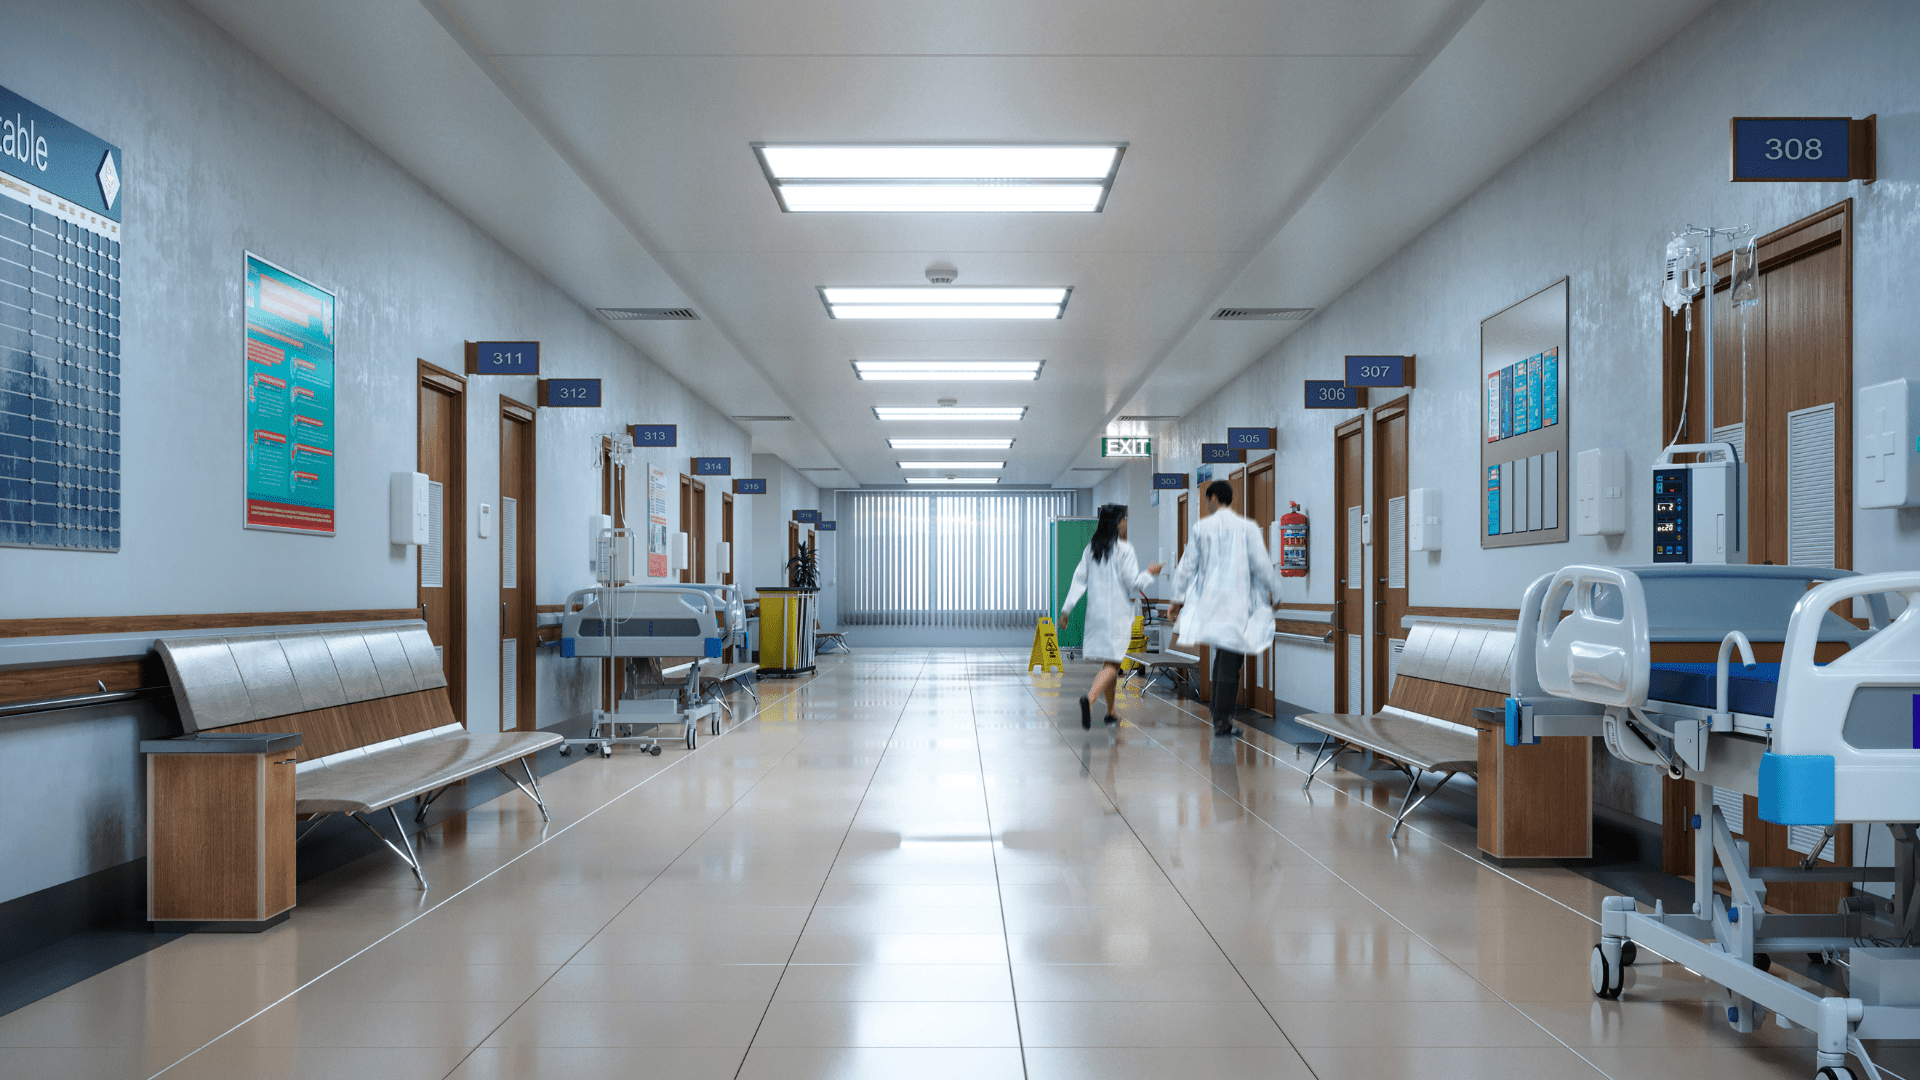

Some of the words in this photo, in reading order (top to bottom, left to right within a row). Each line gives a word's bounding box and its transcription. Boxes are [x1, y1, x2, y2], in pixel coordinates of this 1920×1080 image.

[1765, 138, 1823, 160] 308
[493, 352, 522, 365] 311
[1361, 365, 1390, 378] 307
[560, 387, 587, 399] 312
[1319, 387, 1346, 401] 306
[644, 431, 666, 441] 313
[1238, 434, 1260, 443] 305
[1107, 438, 1149, 455] EXIT
[1211, 449, 1231, 458] 304
[704, 462, 722, 471] 314
[1160, 477, 1177, 485] 303
